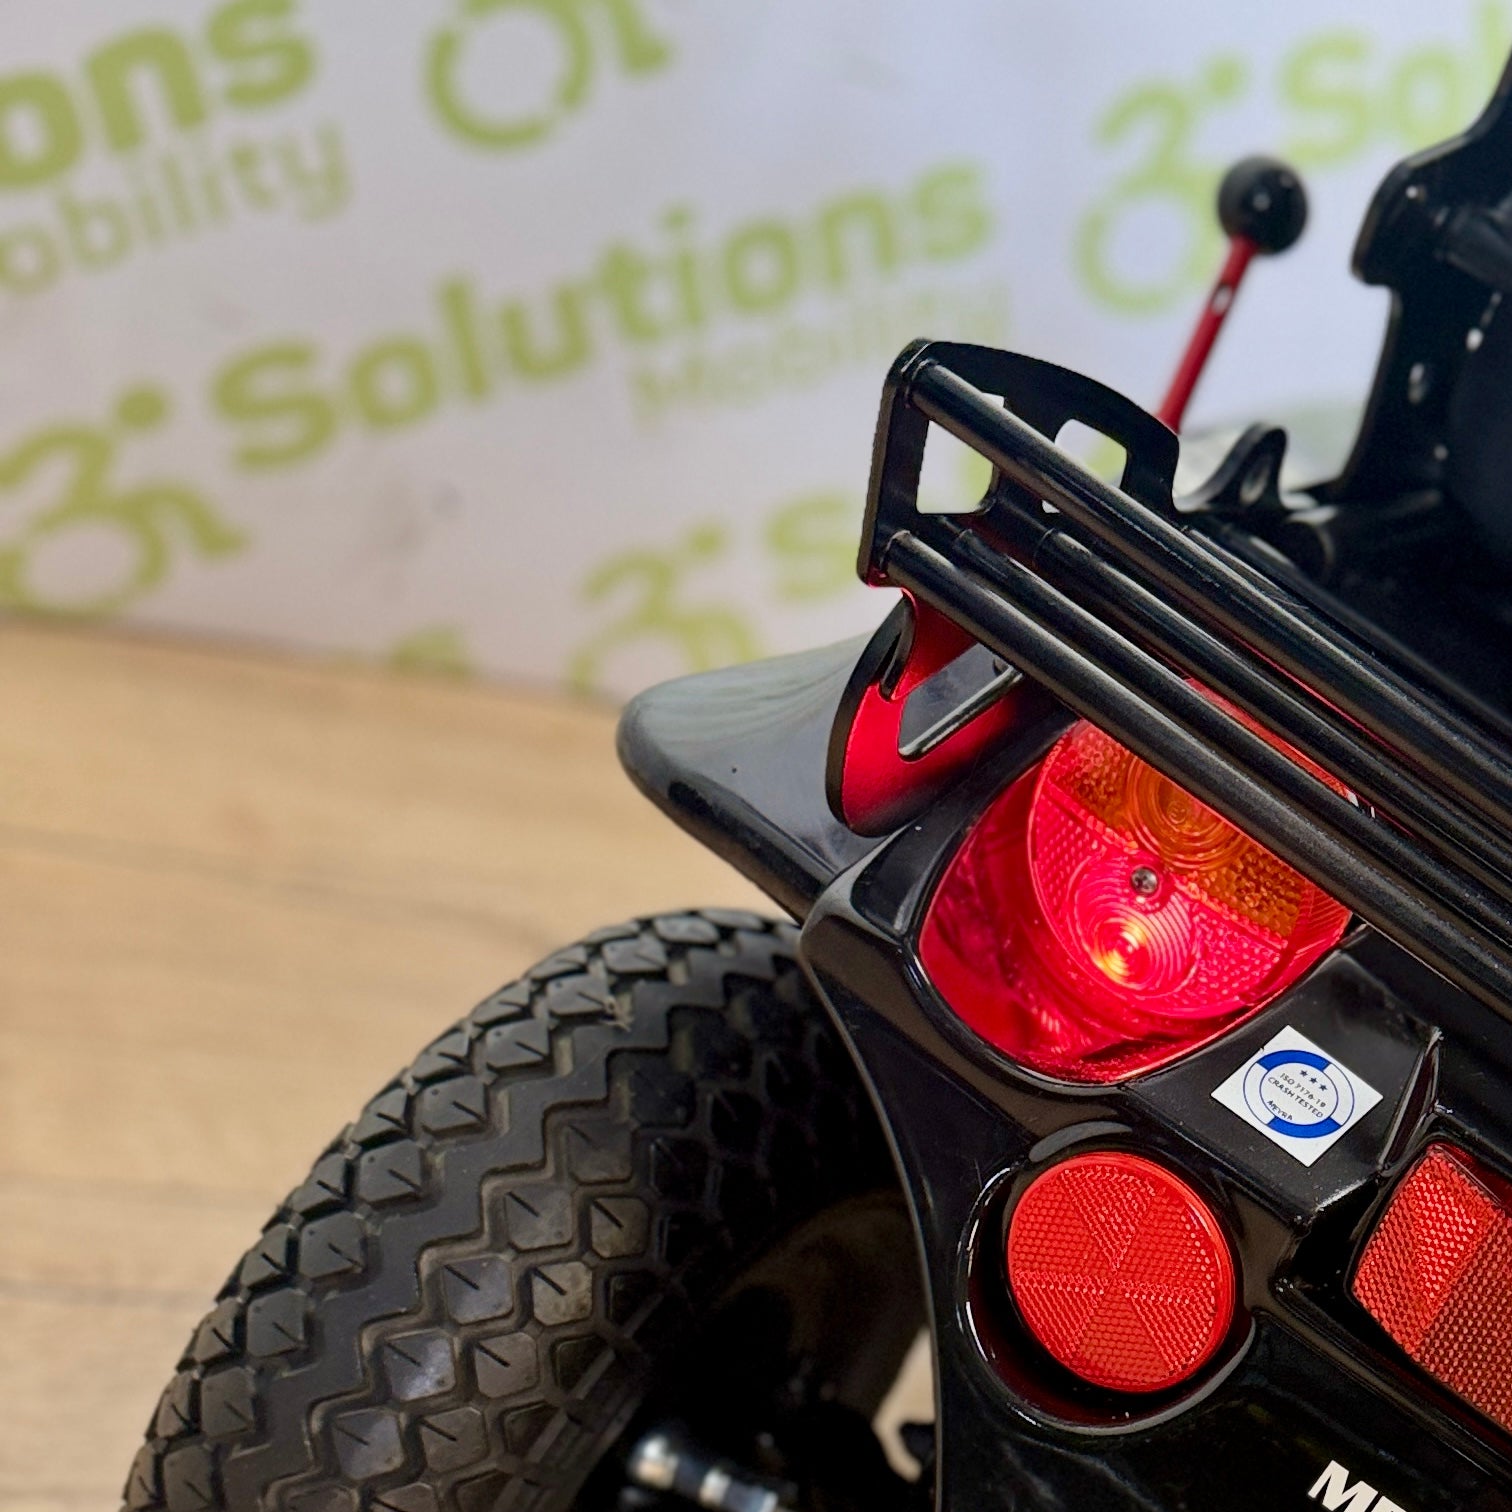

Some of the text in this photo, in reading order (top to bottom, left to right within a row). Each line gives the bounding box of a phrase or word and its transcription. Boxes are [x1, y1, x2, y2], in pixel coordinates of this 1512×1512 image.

[208, 155, 996, 476] Solutions
[1281, 1073, 1295, 1086] ISO
[1268, 1077, 1323, 1118] CRASH TESTED
[1268, 1100, 1293, 1120] MEYRA
